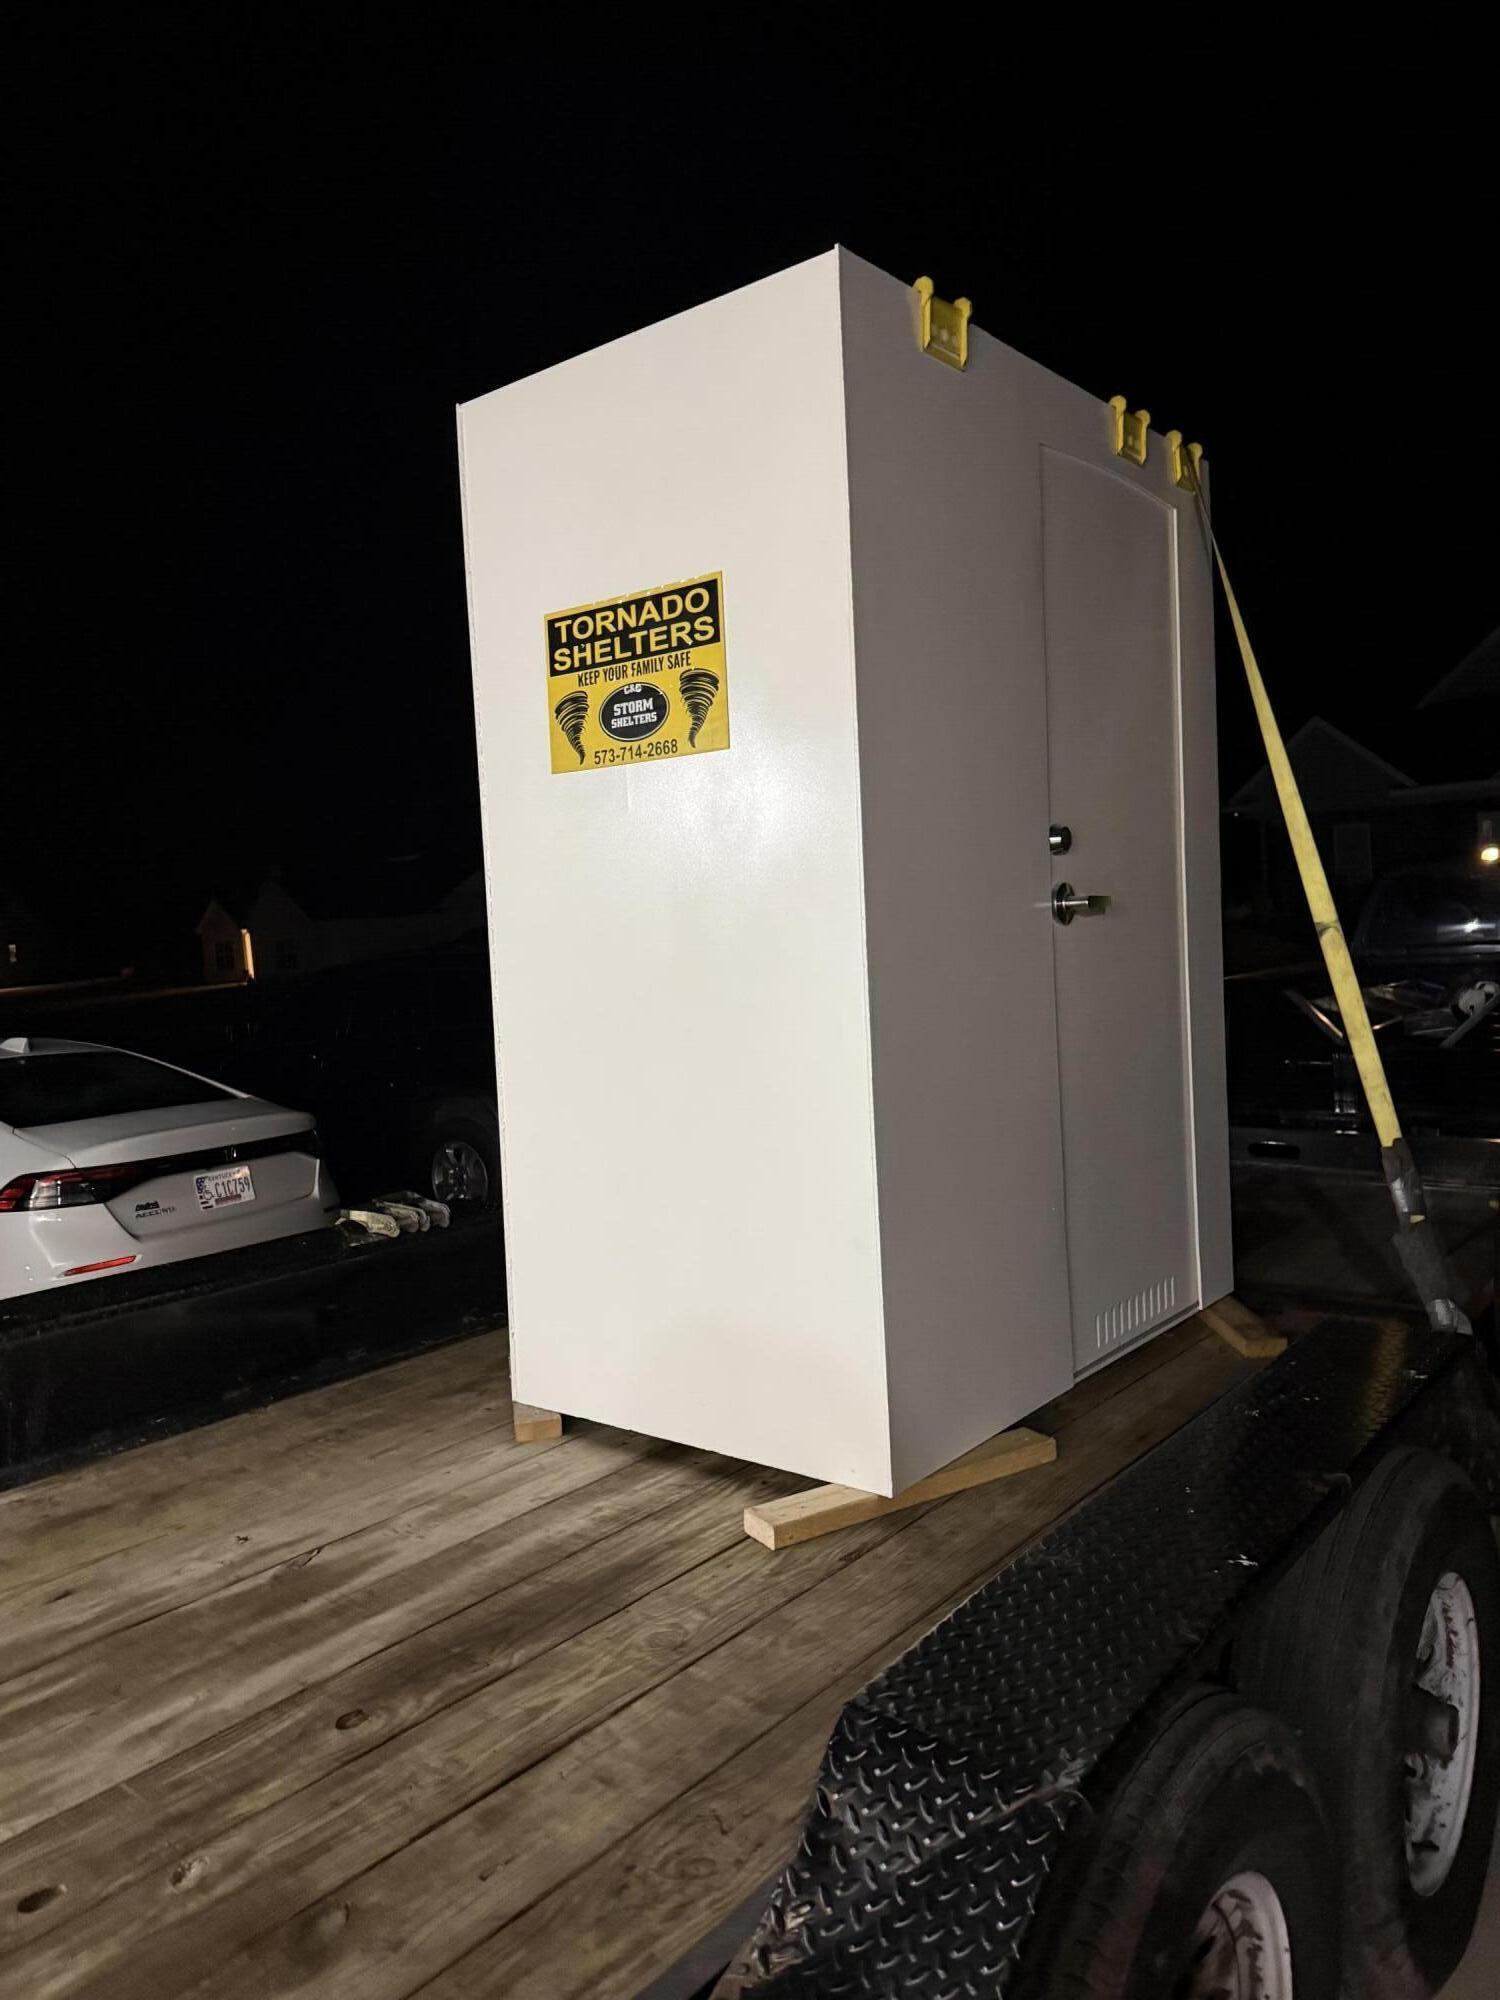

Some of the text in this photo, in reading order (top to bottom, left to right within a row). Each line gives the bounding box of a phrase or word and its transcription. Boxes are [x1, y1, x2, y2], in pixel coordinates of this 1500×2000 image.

[554, 588, 710, 643] TORNADO
[554, 616, 715, 671] SHELTERS
[578, 651, 691, 687] KEEP YOUR FAMILY SAFE
[611, 711, 657, 729] SHELTERS
[613, 697, 654, 716] STORM
[594, 739, 678, 765] 573-714-2668
